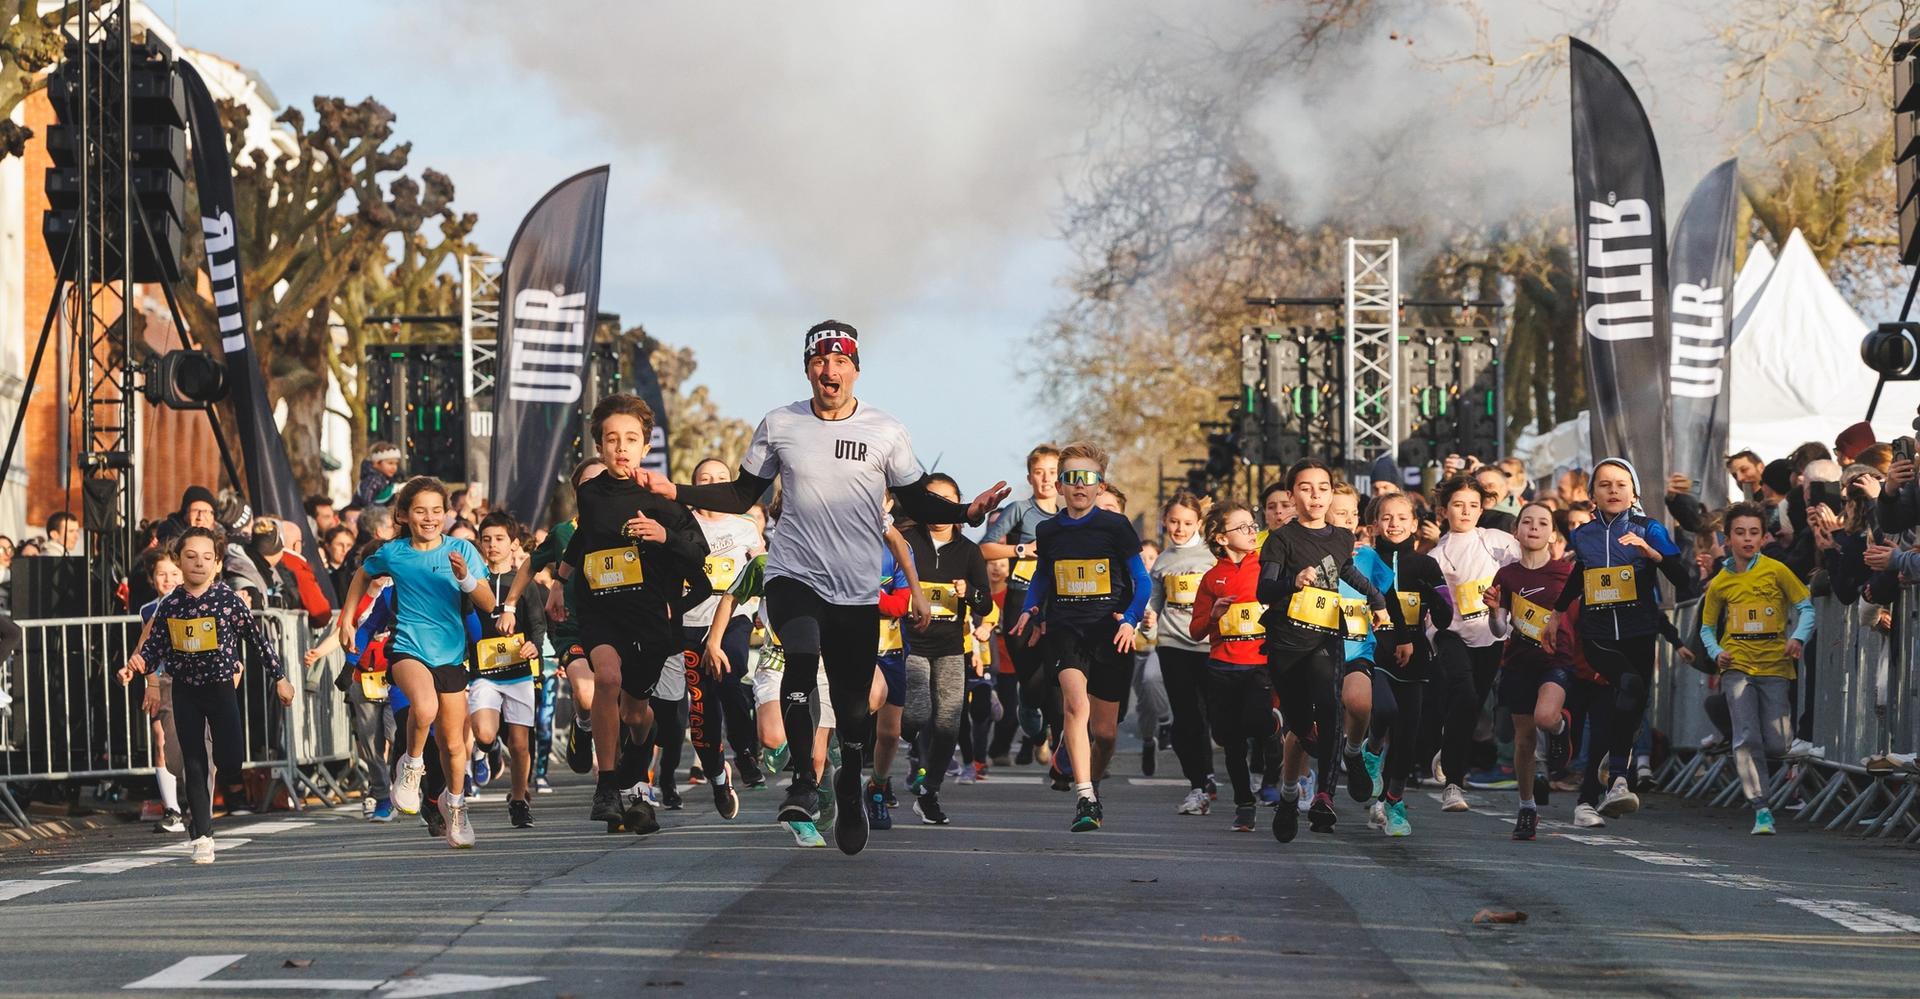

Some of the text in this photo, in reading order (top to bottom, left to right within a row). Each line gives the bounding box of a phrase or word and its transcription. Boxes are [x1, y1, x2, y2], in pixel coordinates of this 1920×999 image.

[510, 288, 587, 404] UTLR
[1670, 283, 1724, 398] UTLR
[835, 439, 868, 462] UTLR
[931, 589, 942, 601] 29
[1315, 596, 1326, 609] 89
[185, 625, 195, 638] 42
